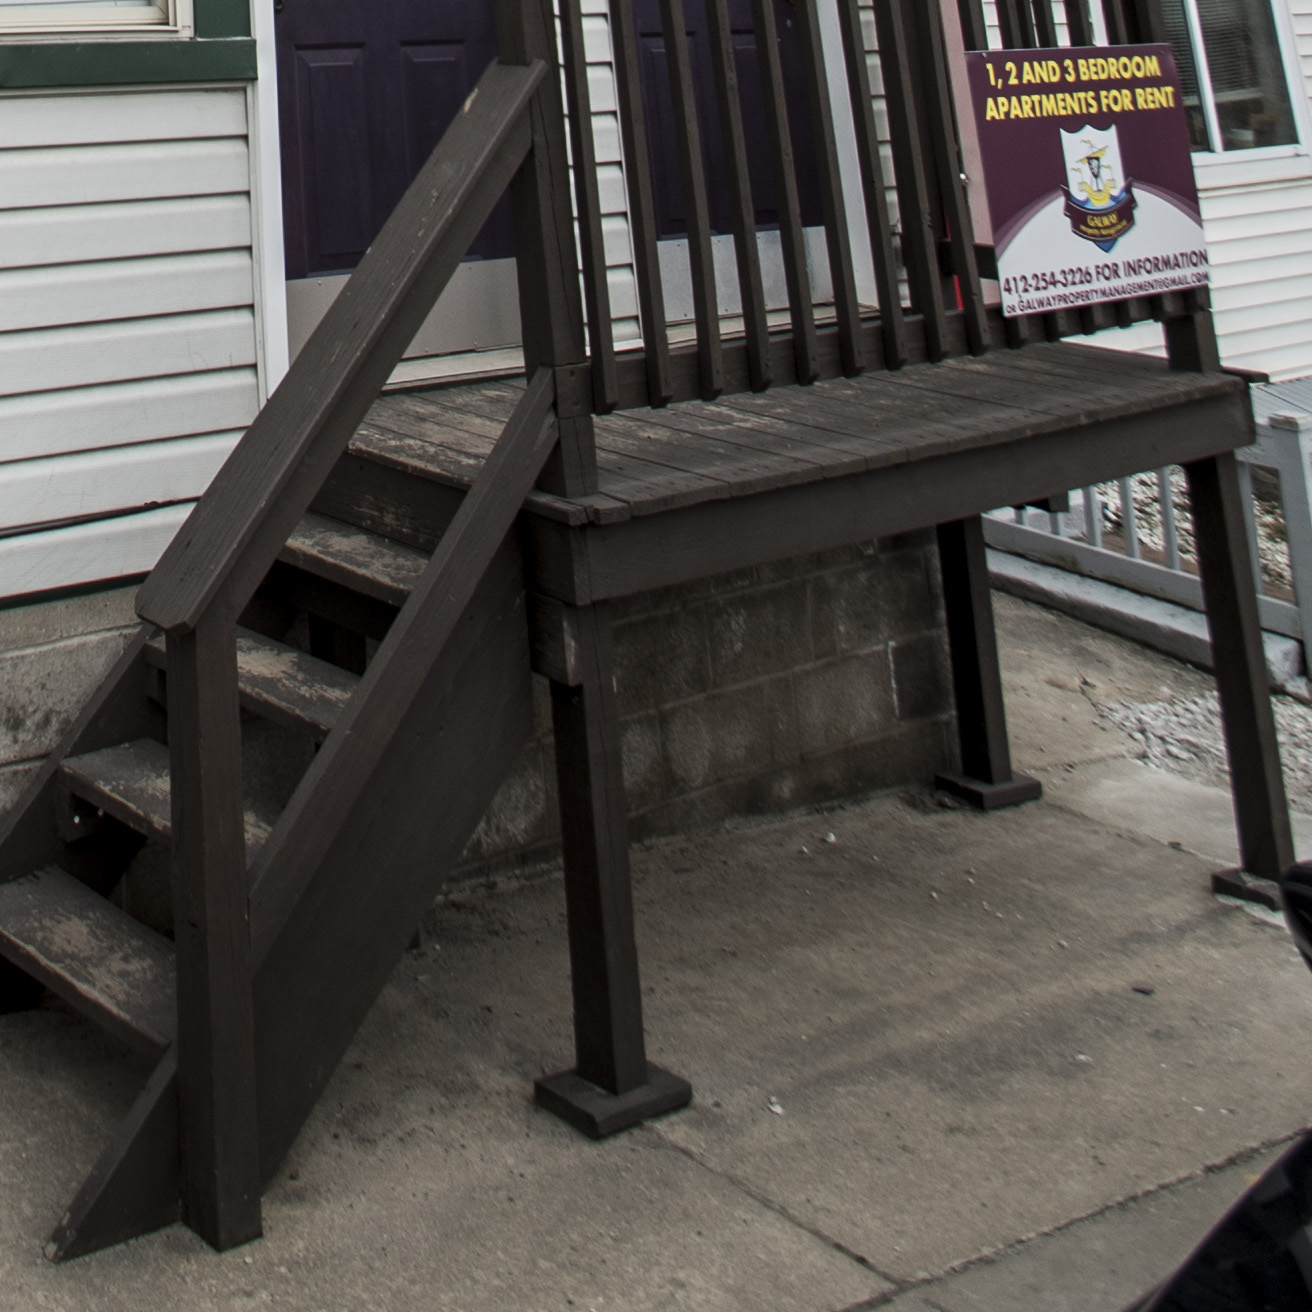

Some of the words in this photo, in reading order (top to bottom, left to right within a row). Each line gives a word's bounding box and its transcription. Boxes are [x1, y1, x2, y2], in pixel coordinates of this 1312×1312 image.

[985, 63, 1003, 89] 1,
[1005, 61, 1019, 86] 2
[1022, 60, 1061, 84] AND
[1063, 58, 1076, 82] 3
[1077, 55, 1162, 81] BEDROOM
[986, 90, 1098, 121] APARTMENTS
[1099, 89, 1135, 113] FOR
[1134, 86, 1175, 110] RENT
[1003, 266, 1092, 295] 412-254-3226
[1094, 262, 1121, 282] FOR
[1122, 249, 1208, 276] INFORMATION
